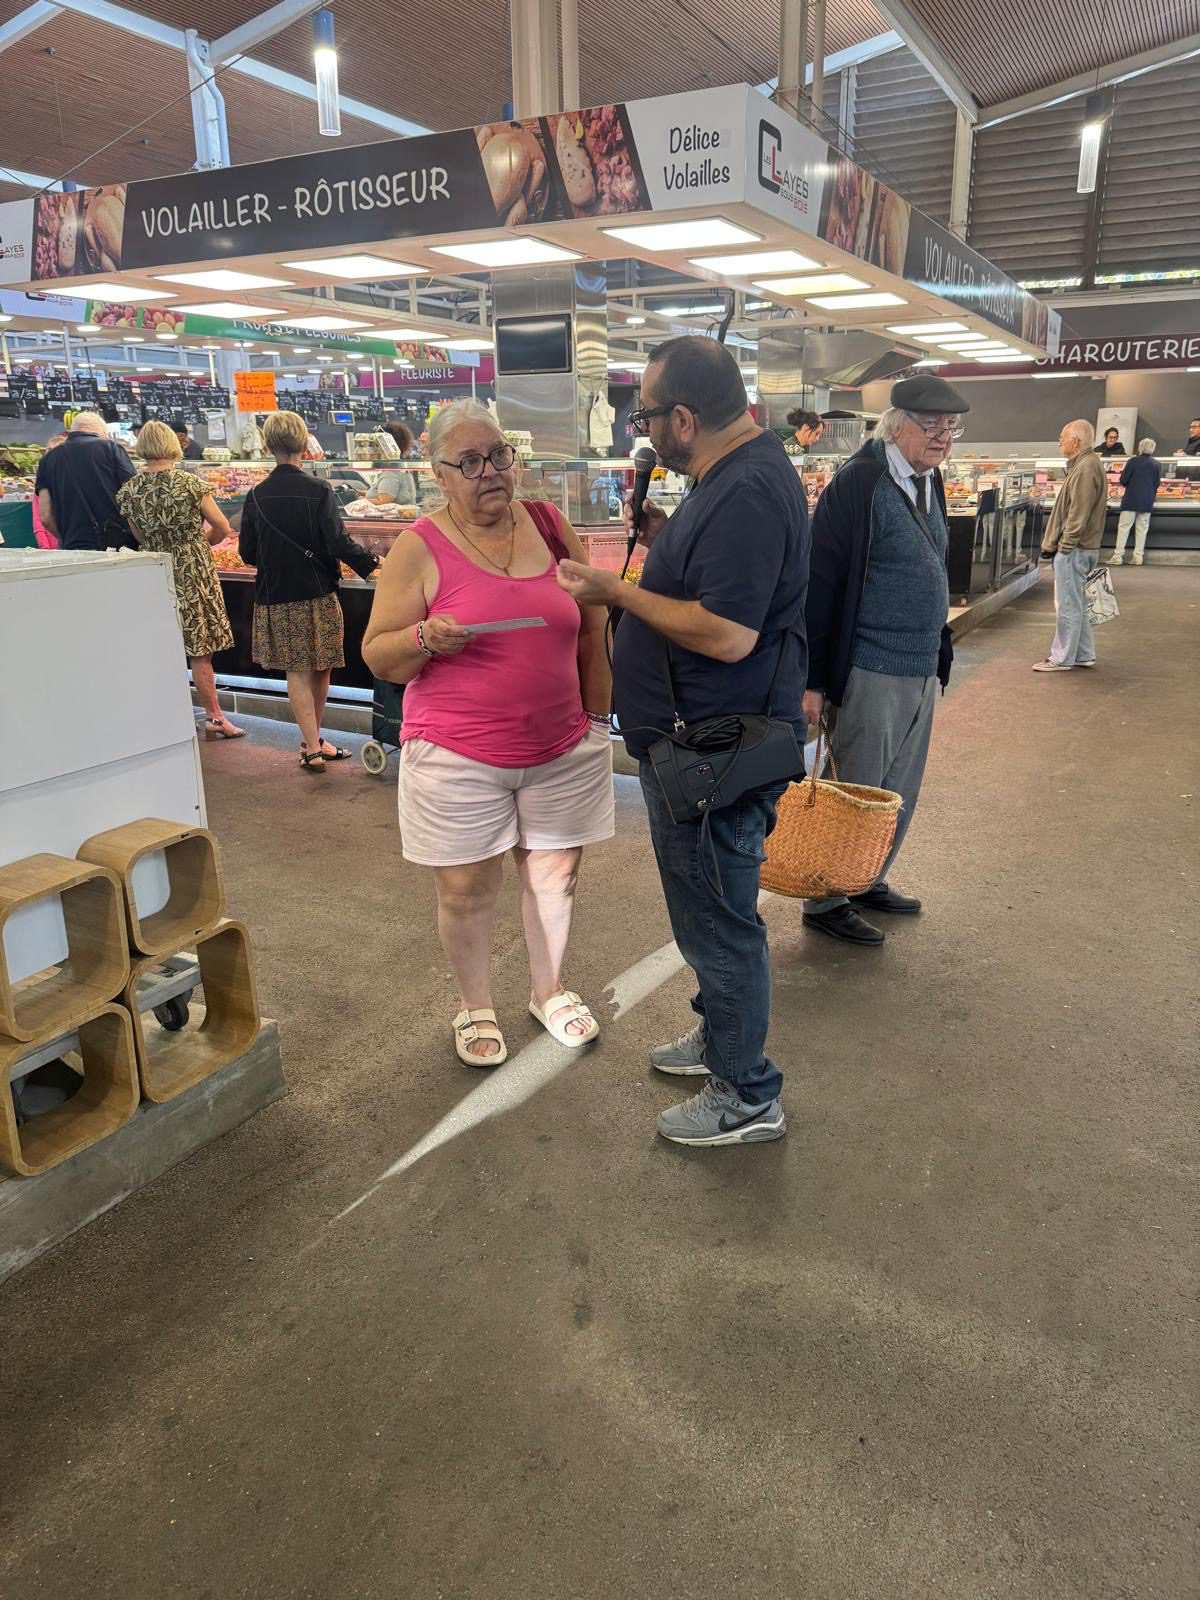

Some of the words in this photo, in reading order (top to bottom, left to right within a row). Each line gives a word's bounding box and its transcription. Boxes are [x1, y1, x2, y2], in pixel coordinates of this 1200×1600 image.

[669, 124, 720, 154] Délice
[663, 158, 730, 191] Volailles
[141, 192, 272, 238] VOLAILLER
[294, 166, 450, 218] RÔTISSEUR
[925, 236, 975, 302] VOLAILLER
[401, 368, 455, 380] FLEURISTE
